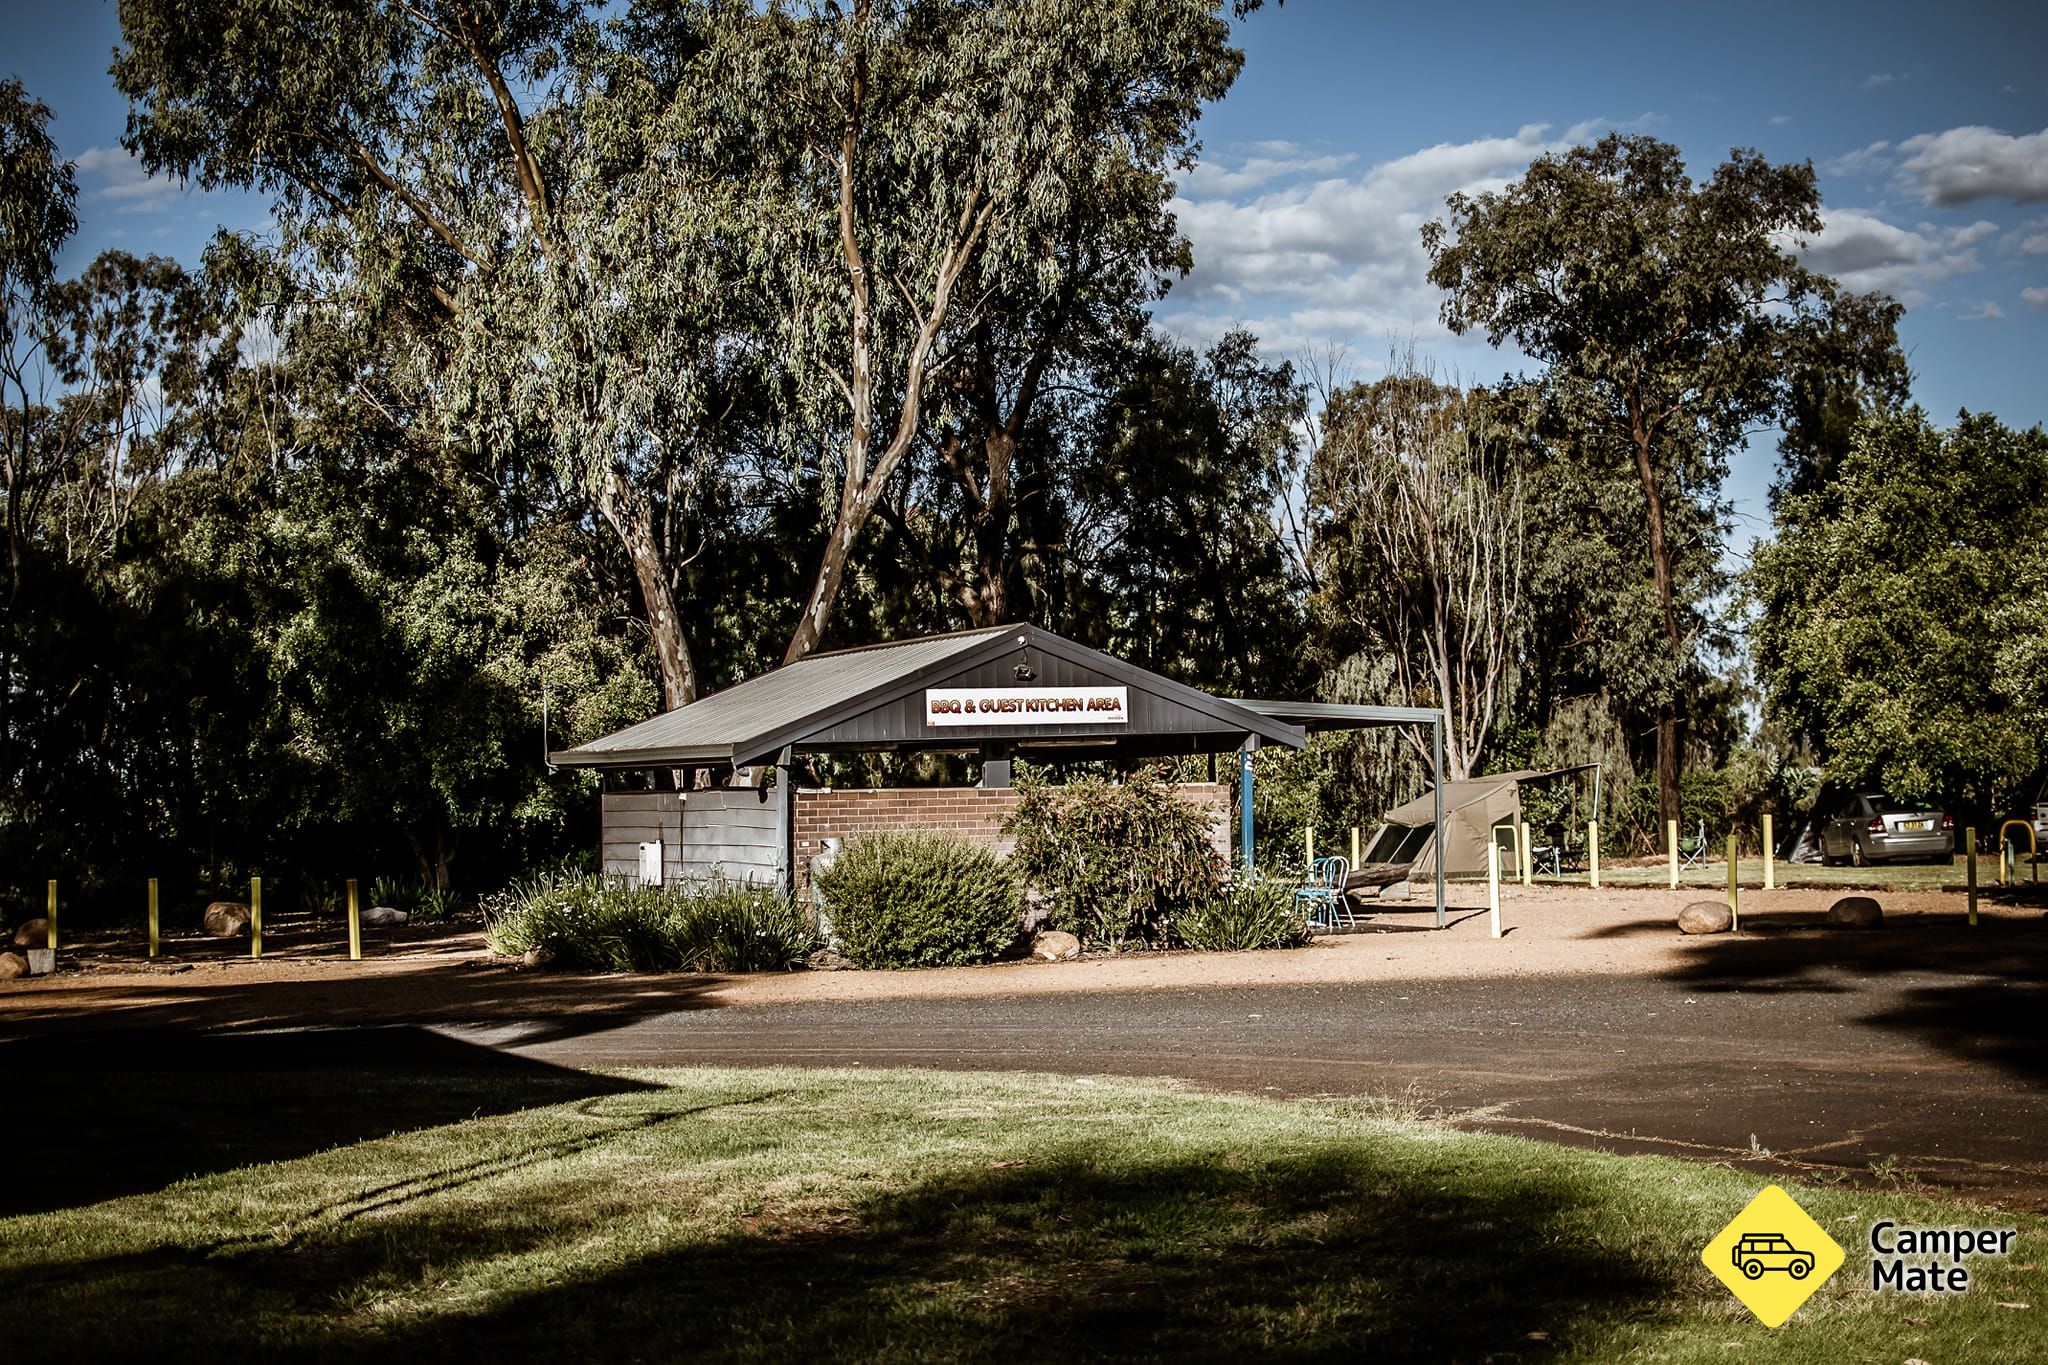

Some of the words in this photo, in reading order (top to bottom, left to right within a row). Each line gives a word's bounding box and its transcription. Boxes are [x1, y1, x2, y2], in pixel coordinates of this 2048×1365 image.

[931, 699, 961, 714] BBQ
[964, 699, 976, 713] &
[979, 698, 1024, 713] GUEST
[1025, 698, 1084, 712] KITCHEN
[1086, 697, 1121, 712] AREA
